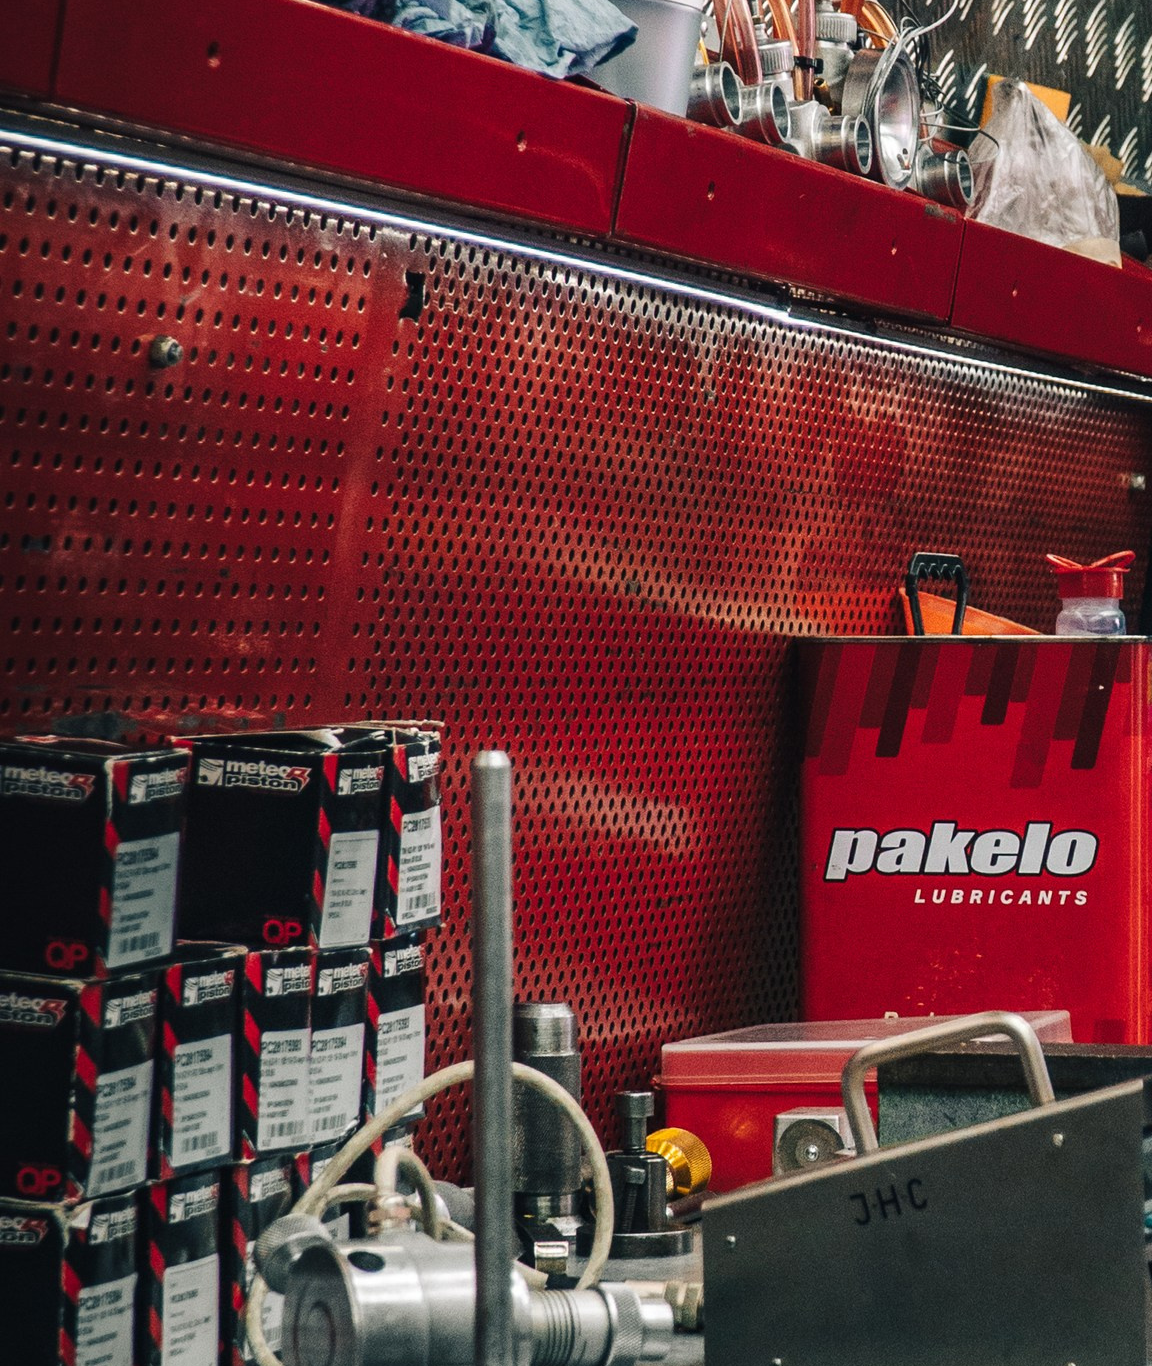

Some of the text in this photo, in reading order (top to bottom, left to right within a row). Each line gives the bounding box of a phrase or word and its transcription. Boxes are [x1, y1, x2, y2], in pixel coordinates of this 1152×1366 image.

[4, 780, 83, 800] piston
[225, 773, 299, 791] piston
[351, 778, 381, 795] piston
[825, 821, 1099, 882] pakelo
[914, 888, 1090, 906] LUBRICANTS
[198, 985, 231, 1004] piston
[332, 976, 364, 995] piston
